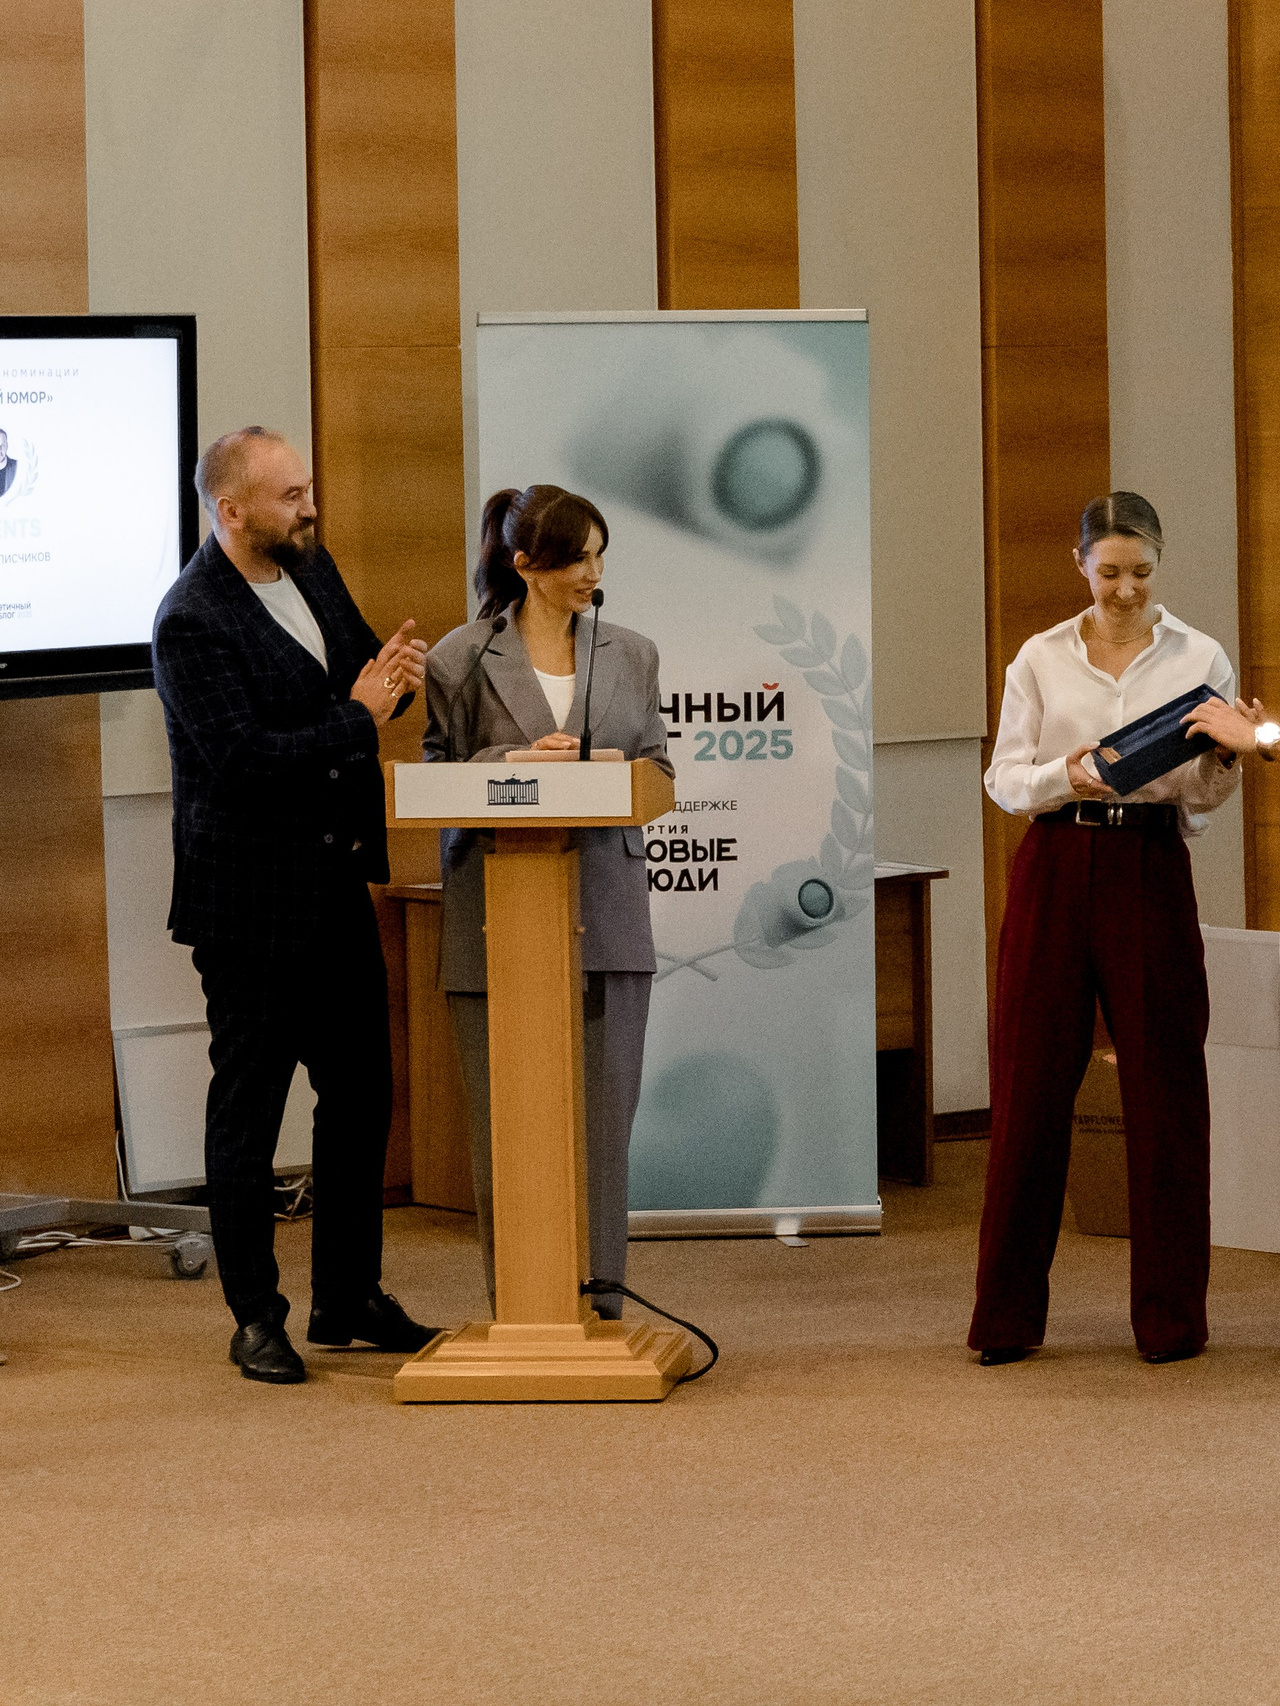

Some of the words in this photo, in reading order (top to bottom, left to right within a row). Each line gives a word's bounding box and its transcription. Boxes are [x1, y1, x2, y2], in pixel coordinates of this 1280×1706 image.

[3, 368, 79, 379] номинации
[7, 391, 53, 404] ЮМОР»
[0, 517, 42, 539] NTS
[659, 683, 785, 723] ЧНЫЙ
[694, 729, 794, 761] 2025
[647, 824, 688, 834] РТИЯ
[645, 838, 738, 863] ОВЫЕ
[647, 867, 719, 892] ЮДИ
